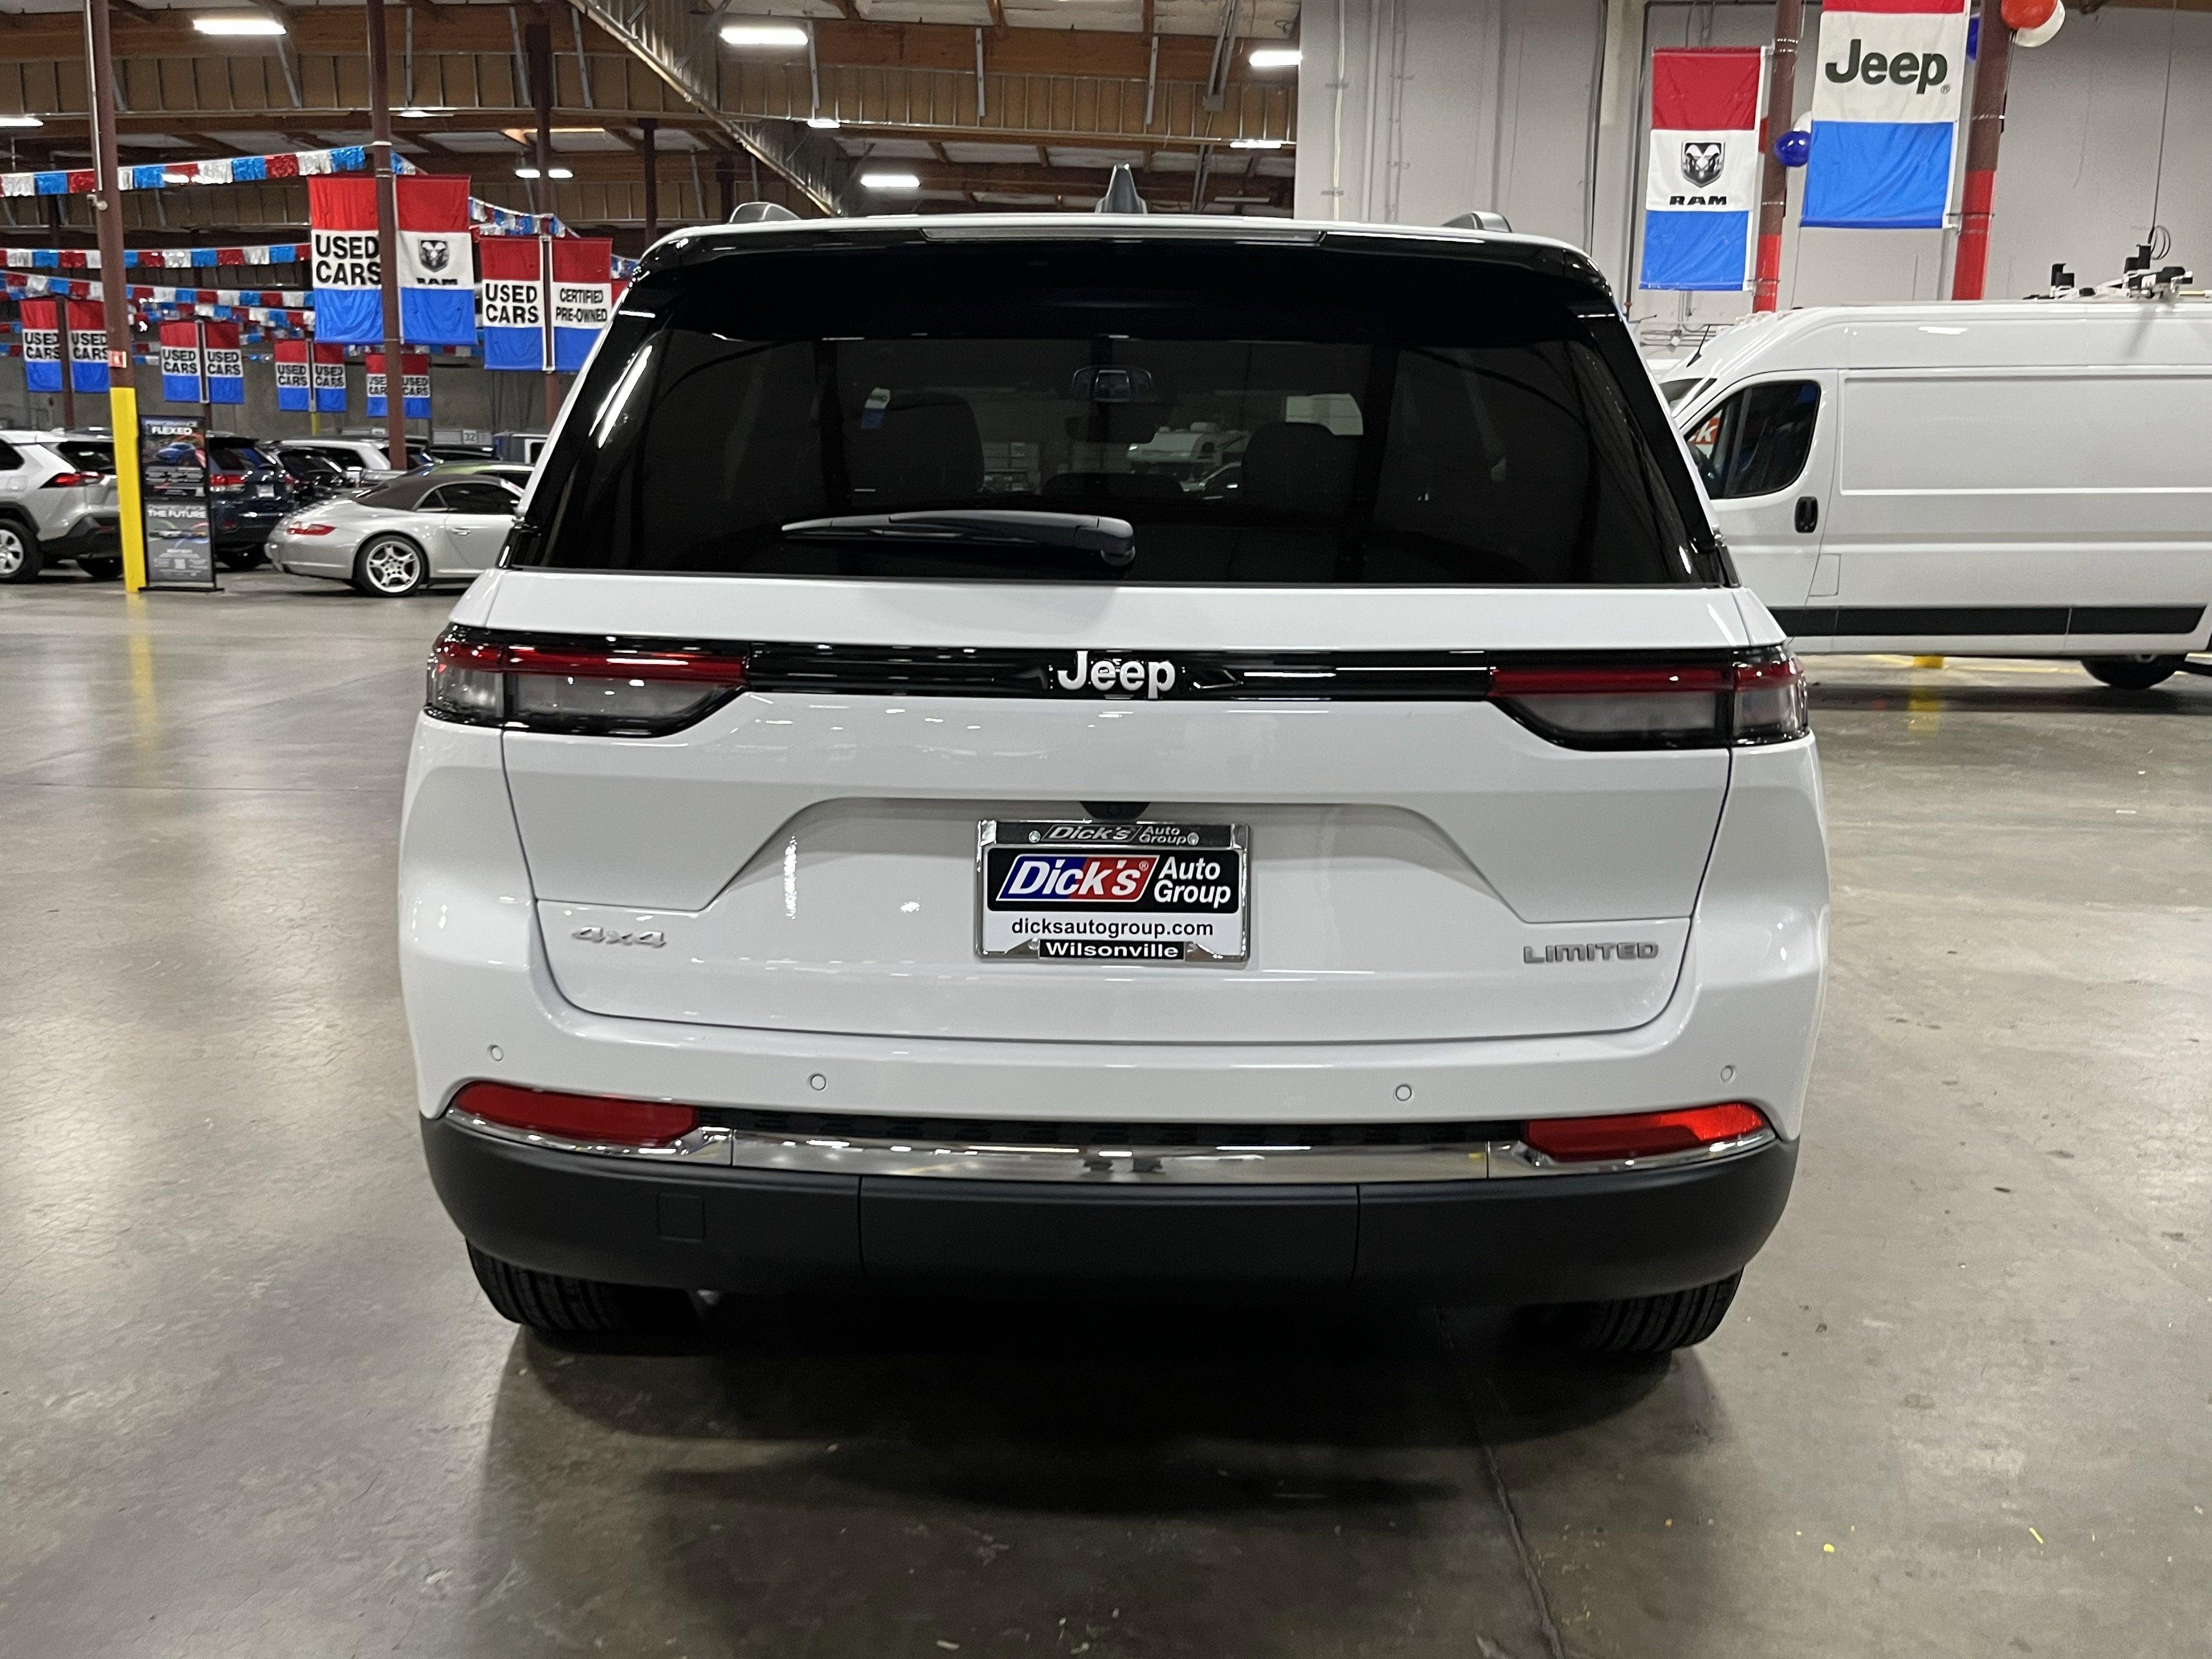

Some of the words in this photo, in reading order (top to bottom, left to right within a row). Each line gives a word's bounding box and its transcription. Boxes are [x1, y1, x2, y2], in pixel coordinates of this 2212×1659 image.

[1825, 39, 1948, 94] Jeep
[1669, 196, 1727, 206] RAM
[315, 235, 380, 259] USED
[316, 261, 381, 285] CARS
[416, 277, 458, 286] RAM
[486, 283, 538, 303] USED
[560, 288, 604, 303] CERTIFIED
[486, 304, 539, 324] CARS
[556, 306, 607, 323] PRE-OWNED
[25, 332, 59, 345] USED
[71, 333, 107, 346] USED
[26, 347, 60, 359] CARS
[74, 347, 108, 360] CARS
[163, 349, 196, 362] USED
[207, 351, 239, 363] USED
[164, 362, 198, 374] CARS
[207, 364, 241, 375] CARS
[278, 365, 306, 375] USED
[315, 365, 343, 376] USED
[278, 376, 307, 386] CARS
[315, 376, 344, 387] CARS
[370, 376, 386, 385] USE
[403, 377, 428, 386] USED
[370, 387, 387, 395] CAR
[402, 387, 428, 396] CARS
[1057, 650, 1176, 699] Jeep
[1048, 826, 1131, 840] Dick's
[1143, 826, 1181, 836] Auto
[1138, 834, 1187, 845] Group
[1008, 859, 1141, 896] Dick's
[1158, 856, 1221, 880] Auto
[1154, 879, 1231, 909] Group
[1012, 918, 1214, 939] dicksautogroup.com
[571, 926, 667, 949] 4x4
[1046, 941, 1179, 958] Wilsonville
[1523, 942, 1659, 964] LIMITED
